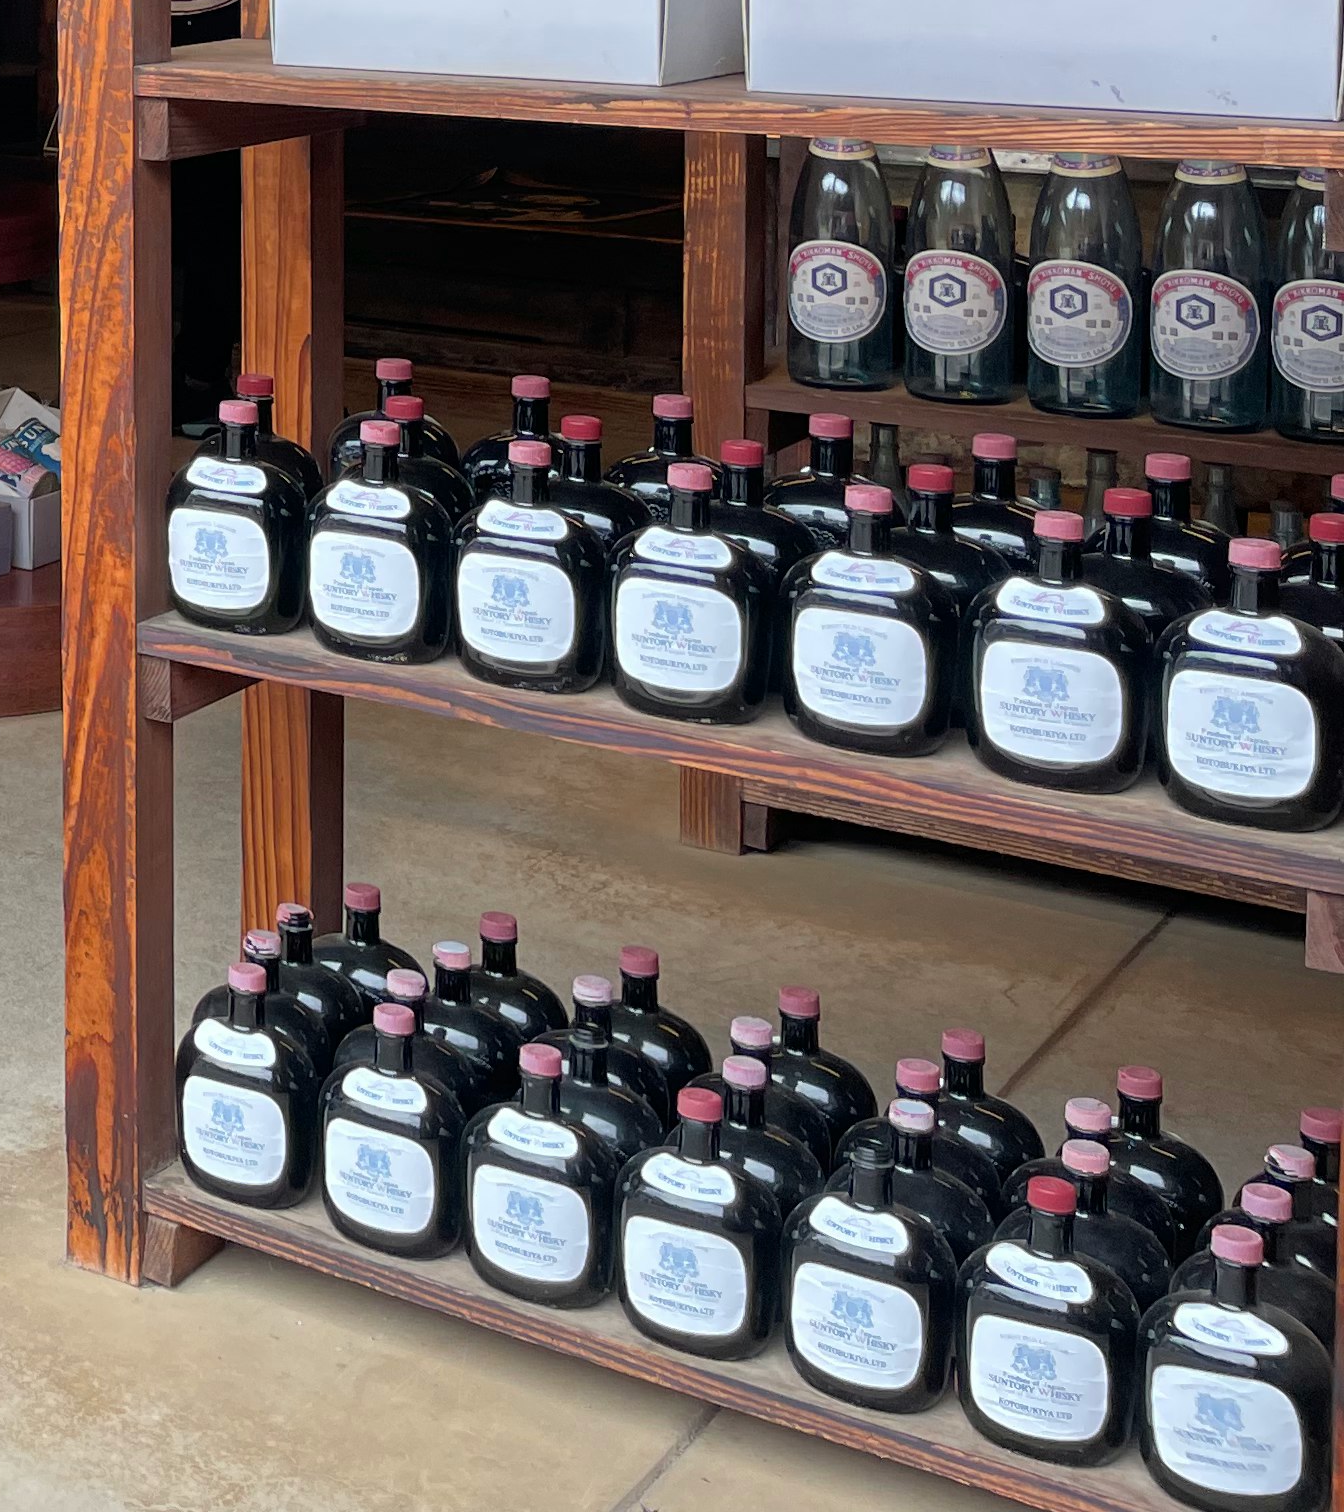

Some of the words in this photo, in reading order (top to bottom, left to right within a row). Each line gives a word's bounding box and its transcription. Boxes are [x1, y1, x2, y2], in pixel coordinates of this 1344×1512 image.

[847, 251, 873, 270] SHOYU
[967, 262, 994, 283] SHOYU
[1087, 272, 1116, 293] SHOYU
[1215, 282, 1244, 304] SHOYU
[180, 559, 212, 571] SUNTORY
[215, 564, 248, 574] WHISKY
[323, 584, 359, 597] SUNTORY
[360, 590, 397, 601] WHISKY
[473, 607, 511, 621] SUNTORY
[514, 613, 552, 626] WHISKY
[631, 633, 674, 648] SUNTORY
[676, 640, 717, 654] WHISKY
[810, 665, 855, 681] SUNTORY
[858, 672, 902, 686] WHISKY
[820, 687, 874, 704] KOTOBUKIYA
[1000, 701, 1047, 717] SUNTORY
[1051, 708, 1097, 722] WHISKY
[1009, 724, 1068, 740] KOTOBUKIYA
[1185, 731, 1237, 749] SUNTORY
[1239, 740, 1288, 756] WHISKY
[1196, 756, 1257, 774] KOTOBUKIYA
